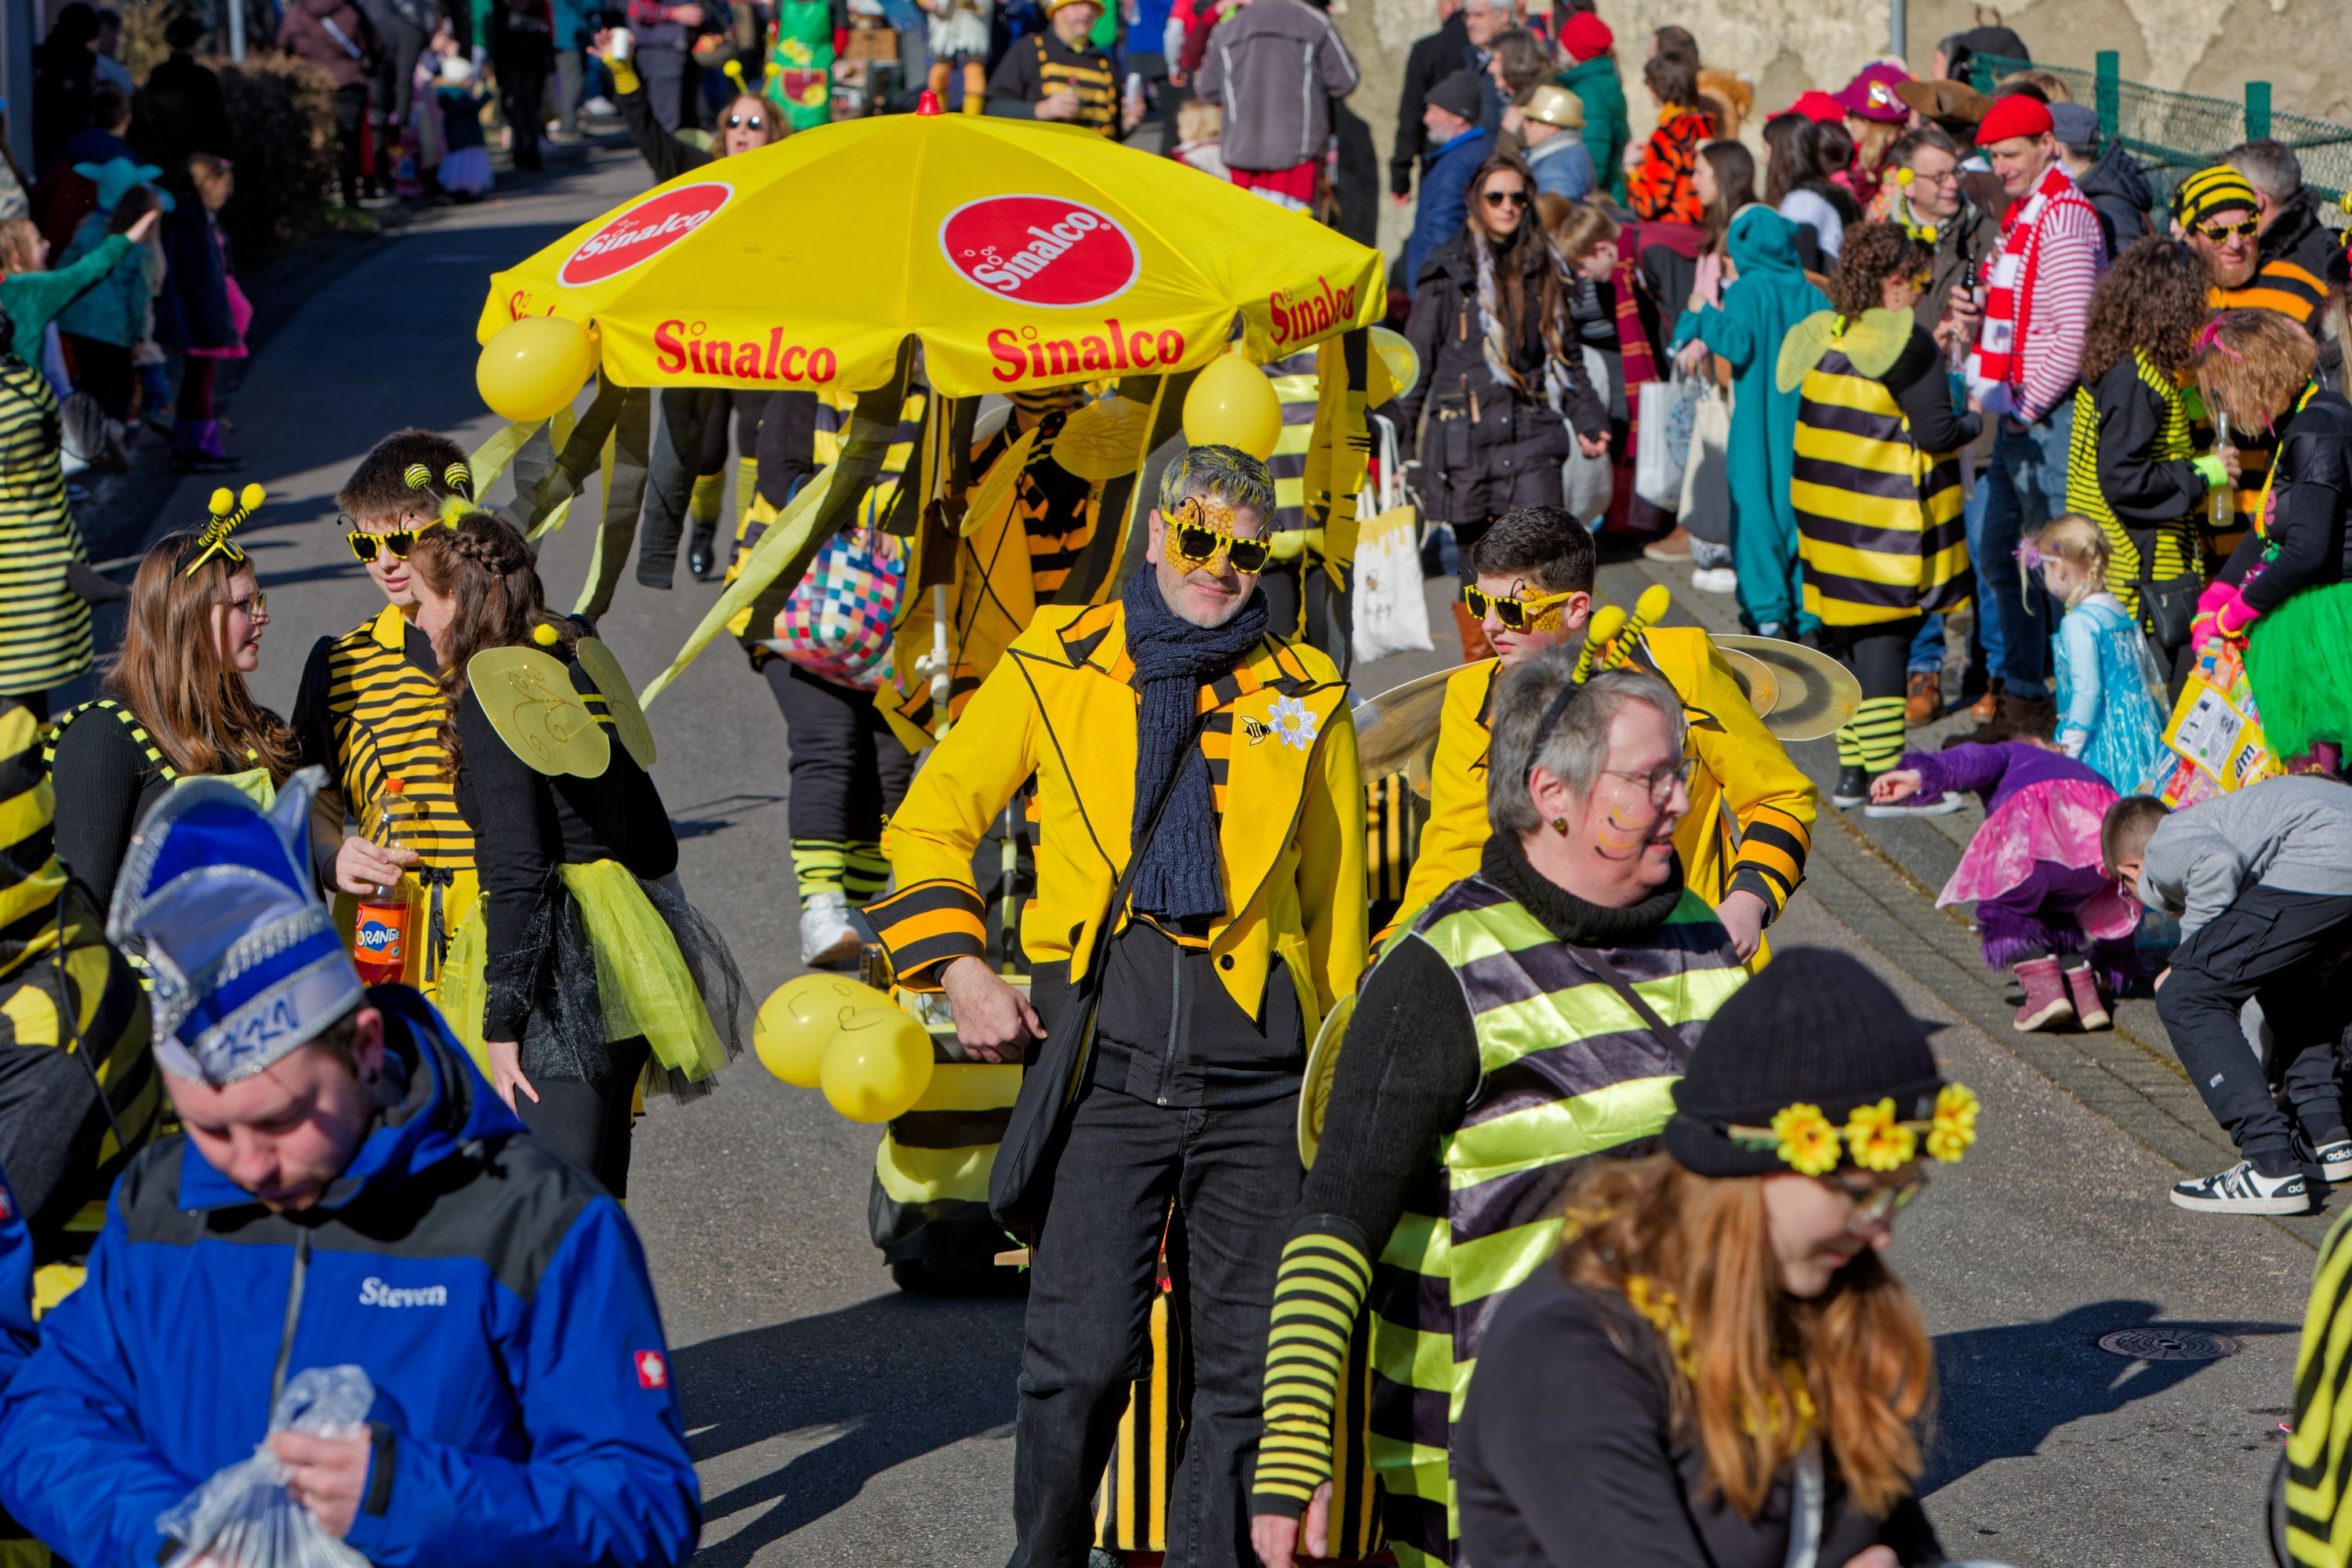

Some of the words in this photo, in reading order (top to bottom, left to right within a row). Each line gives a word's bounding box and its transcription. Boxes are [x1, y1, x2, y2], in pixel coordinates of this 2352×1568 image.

[575, 210, 710, 261] Sinalco
[973, 212, 1098, 291] Sinalco
[655, 320, 837, 384] Sinalco
[988, 318, 1185, 383] Sinalco
[2235, 744, 2256, 779] dm
[357, 927, 401, 947] ORANGE
[359, 1276, 448, 1308] Steven
